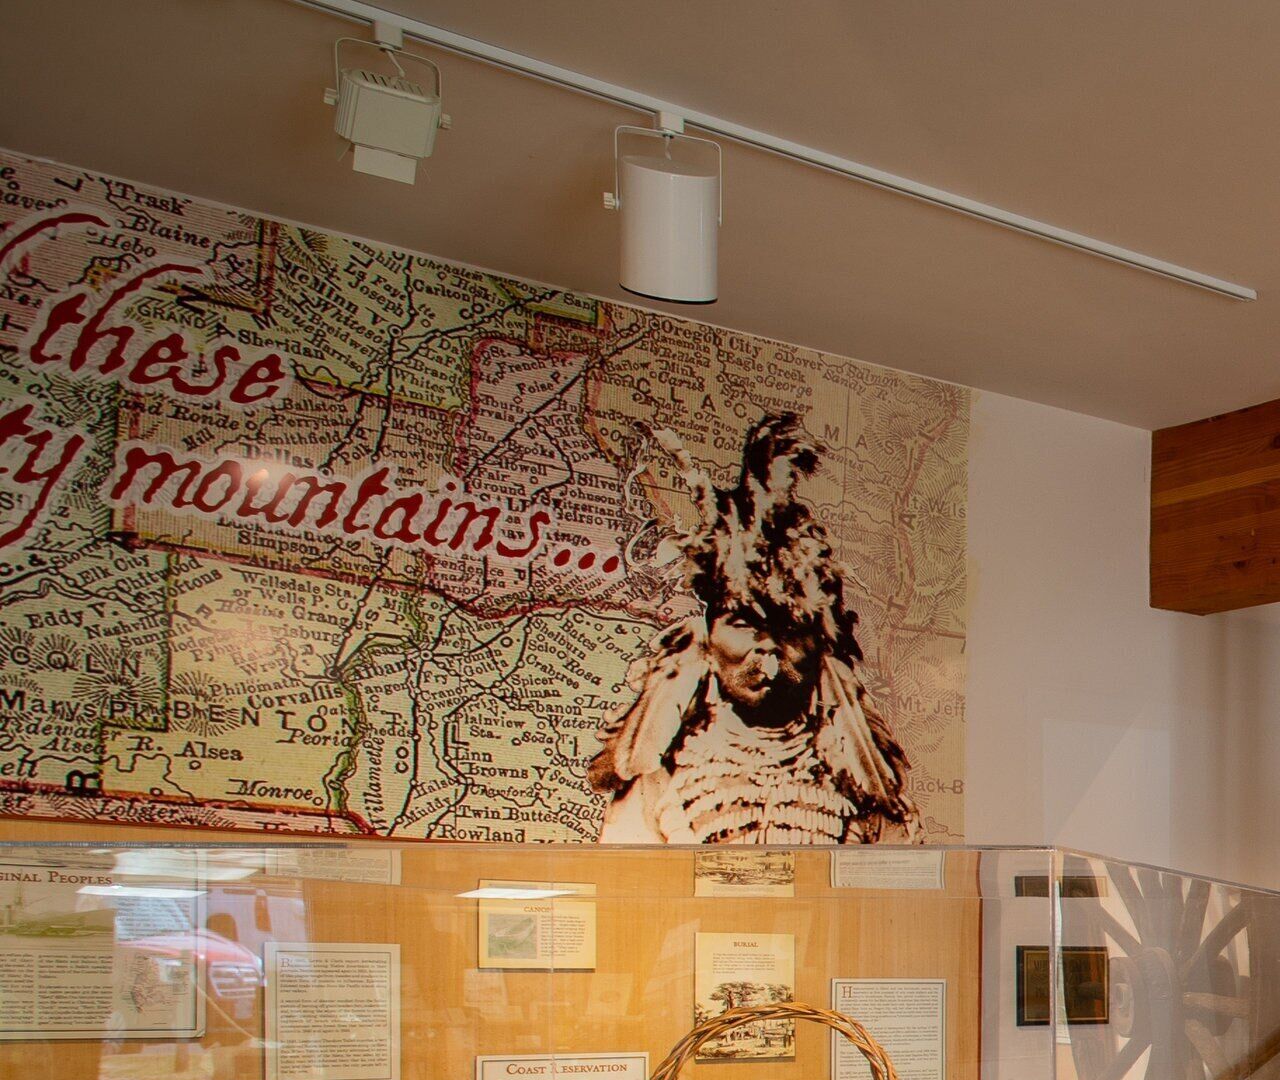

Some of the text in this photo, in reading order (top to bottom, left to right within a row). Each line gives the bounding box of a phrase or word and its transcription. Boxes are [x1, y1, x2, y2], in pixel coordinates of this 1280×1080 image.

[31, 263, 286, 404] these
[729, 335, 762, 359] City
[439, 825, 525, 844] Rowland
[506, 1063, 546, 1075] COAST
